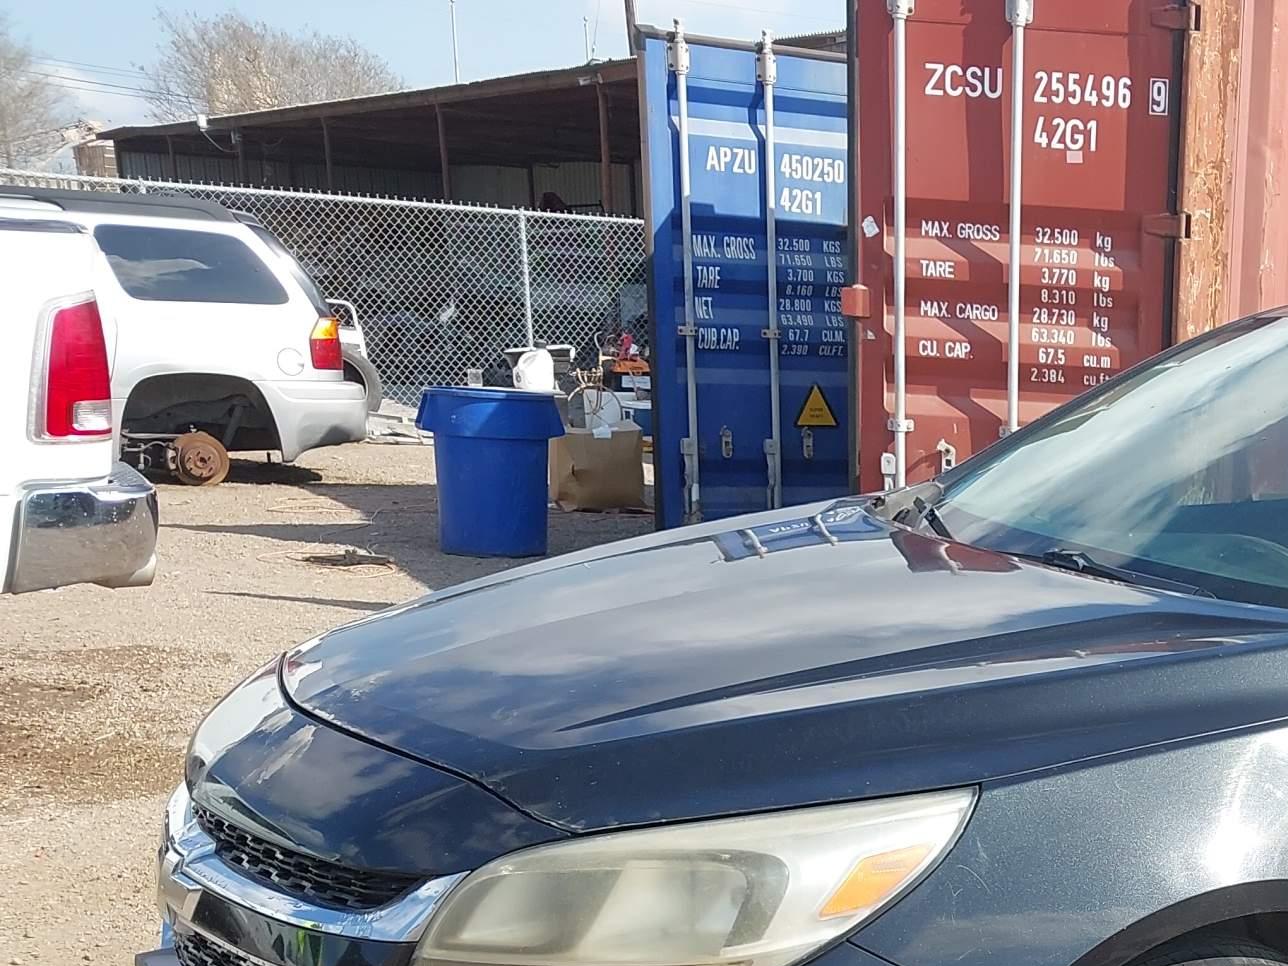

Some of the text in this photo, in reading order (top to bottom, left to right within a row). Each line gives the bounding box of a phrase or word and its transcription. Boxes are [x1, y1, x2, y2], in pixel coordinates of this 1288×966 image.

[924, 63, 1167, 113] ZCSU 255496 9
[1034, 116, 1098, 152] 42G1
[706, 145, 845, 184] APZU 450250
[780, 187, 822, 216] 42G1
[692, 234, 841, 260] MAX. GROSS 32.500 KGS
[921, 220, 1112, 252] MAX. GROSS 32.500 kg
[780, 254, 843, 268] 71.650 LBS
[1034, 248, 1115, 268] 71.650 lbs
[696, 265, 845, 289] TARE 3.700 KGS
[920, 260, 1110, 292] TARE 3.770 kg
[695, 296, 842, 320] NET 28.800 KGS
[1041, 289, 1113, 308] 8.310 lbs
[825, 315, 844, 327] LBS
[920, 300, 1109, 331] MAX. CARGO 28.730 kg
[698, 327, 740, 350] CUB.CAP.
[789, 329, 810, 342] 67.7
[1031, 327, 1112, 348] 63.340 lbs
[918, 340, 1111, 369] CU. CAP. 67.5 cu.m
[1031, 367, 1065, 384] 2.384
